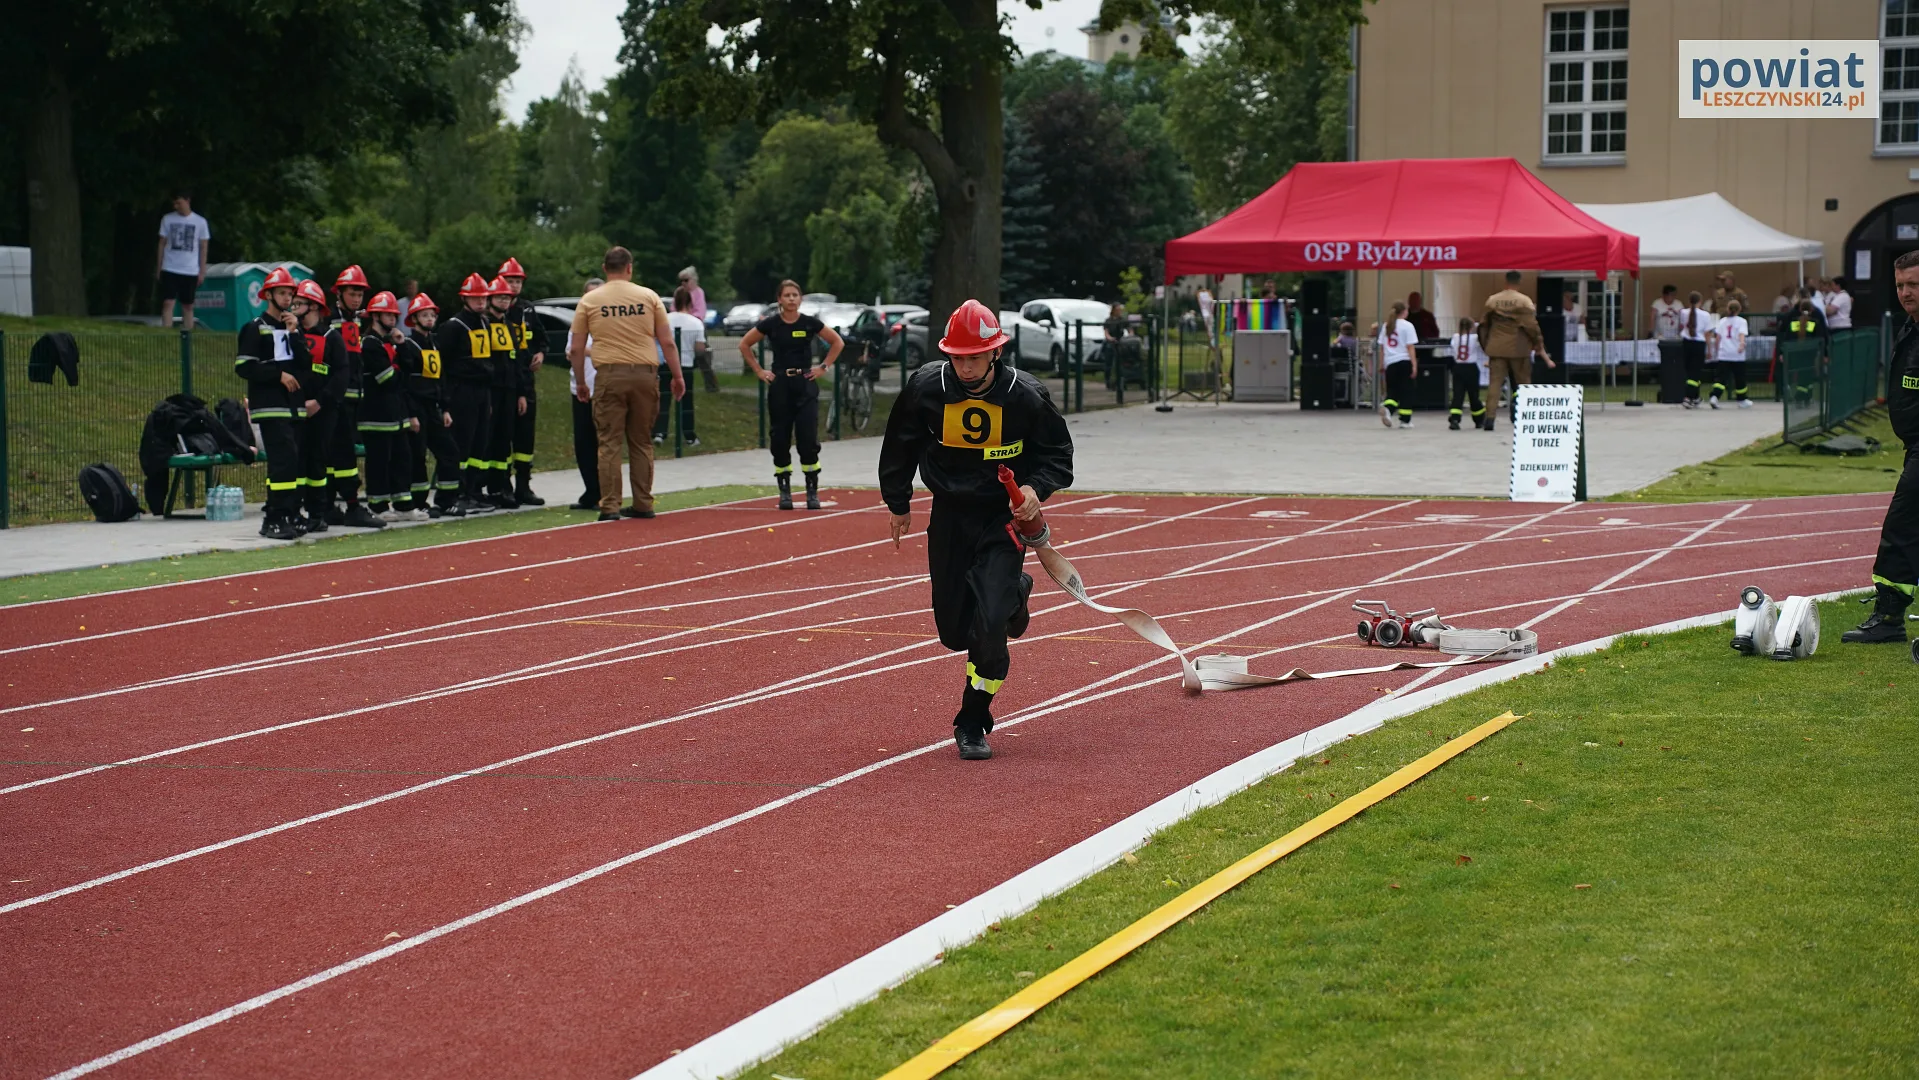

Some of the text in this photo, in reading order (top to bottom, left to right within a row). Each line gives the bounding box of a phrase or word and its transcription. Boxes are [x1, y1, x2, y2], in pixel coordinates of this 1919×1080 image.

[1304, 241, 1457, 266] OSP Rydzyna
[280, 332, 291, 355] 1
[347, 325, 357, 347] 3
[475, 333, 485, 354] 7
[495, 326, 507, 346] 8
[1457, 345, 1468, 361] 8
[428, 353, 438, 374] 6
[1526, 397, 1570, 406] PROSIMY
[1521, 409, 1573, 420] NIE BIEGAĆ
[962, 407, 991, 444] 9
[1522, 424, 1571, 434] PO WEWN.
[1532, 438, 1560, 447] TORZE
[1520, 463, 1569, 472] DZIĘKUJEMY!
